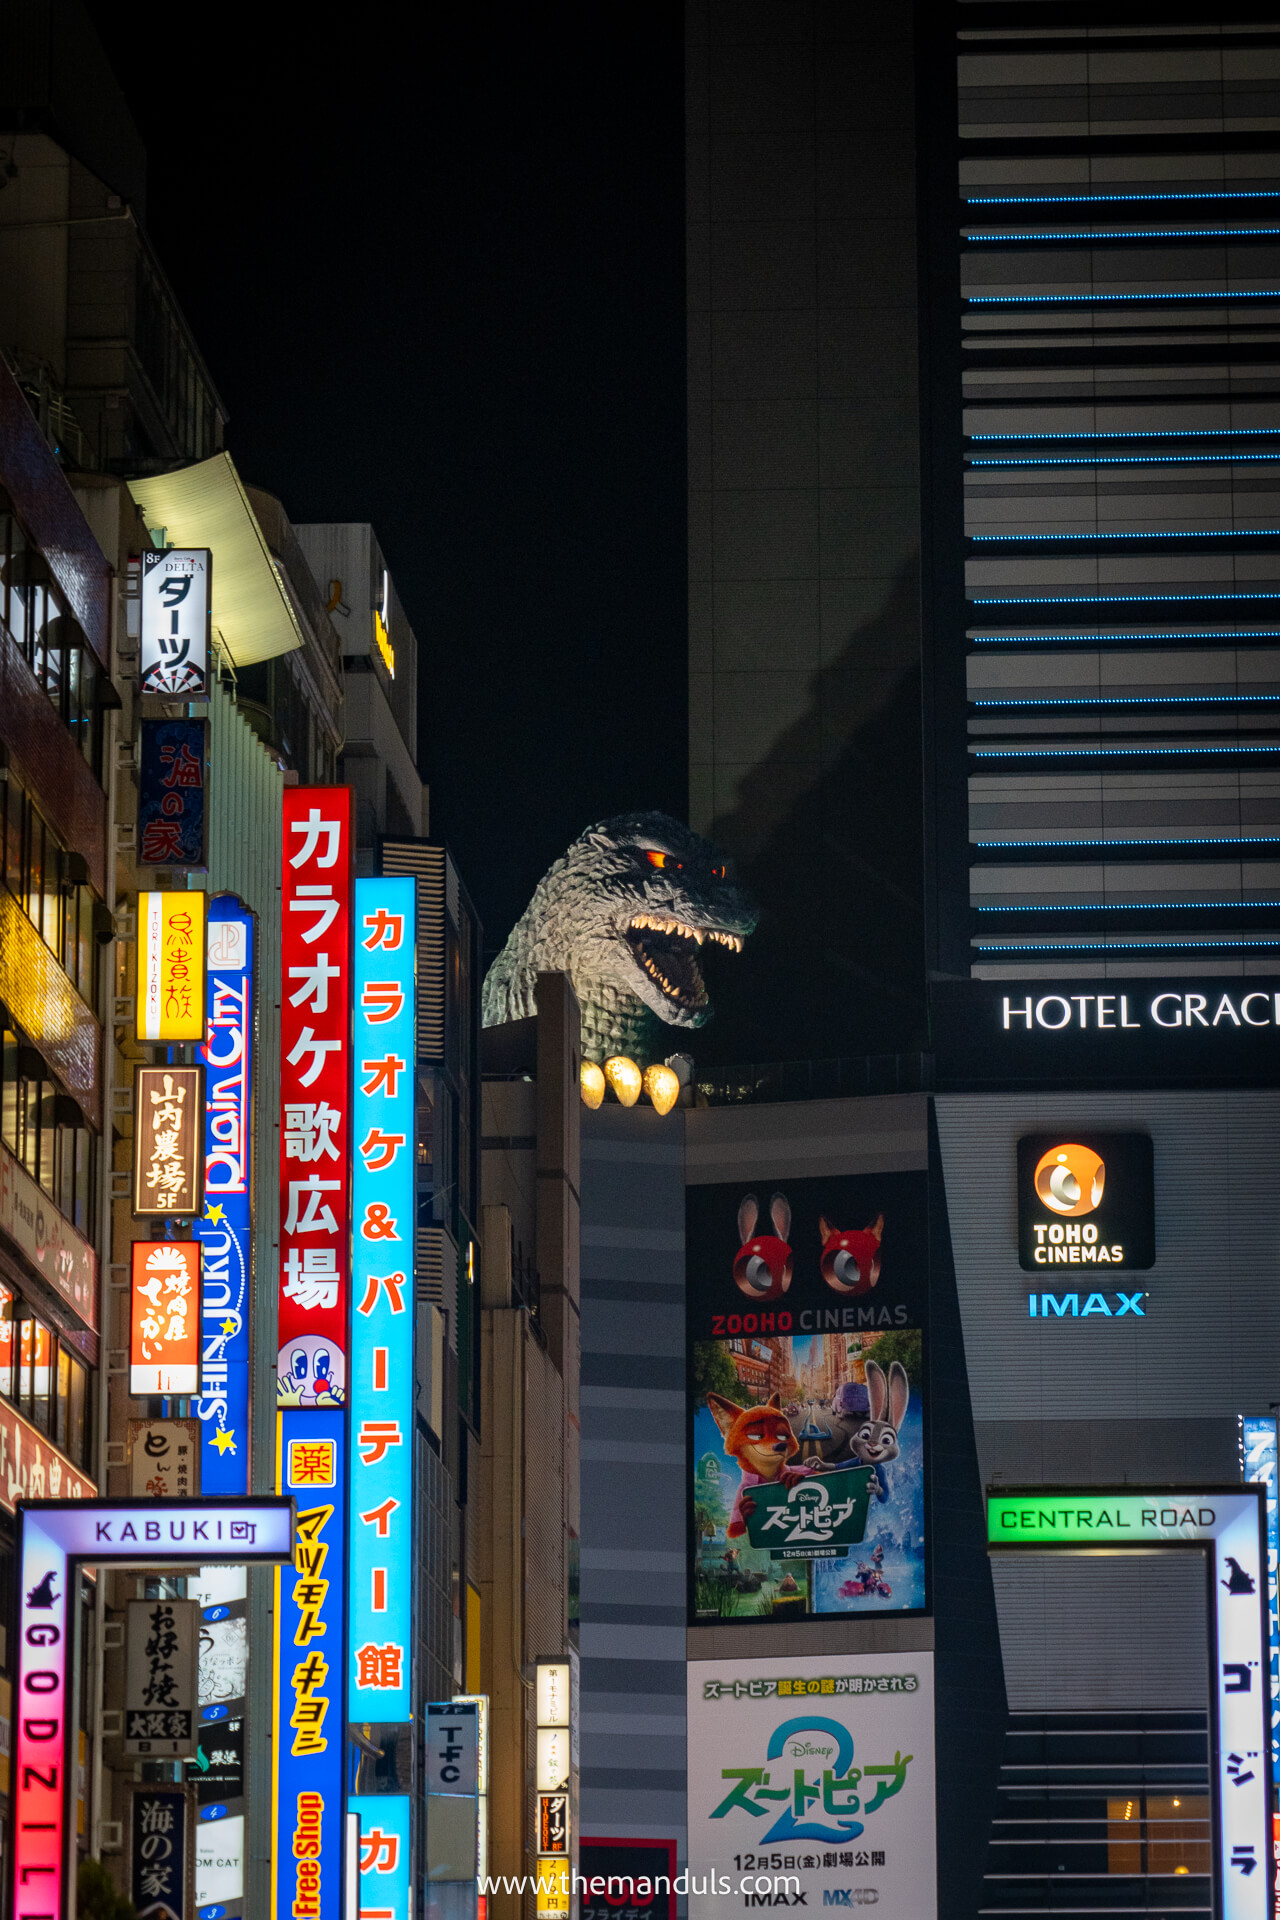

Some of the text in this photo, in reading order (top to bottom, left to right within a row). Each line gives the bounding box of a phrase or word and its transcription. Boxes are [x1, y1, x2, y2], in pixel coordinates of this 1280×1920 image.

[146, 552, 160, 564] 8F
[165, 563, 204, 572] DELTA
[158, 573, 193, 669] ダーツ
[1002, 994, 1141, 1029] HOTEL
[283, 808, 342, 1310] カラオケ歌広場
[145, 1074, 187, 1193] 山内農場
[156, 1193, 177, 1208] 5F
[1033, 1223, 1098, 1244] TOHO
[1033, 1245, 1123, 1264] CINEMAS
[163, 1269, 192, 1341] 焼肉屋
[355, 908, 406, 1690] カラオケ&パーティー館
[1028, 1292, 1146, 1317] IMAX
[136, 1277, 165, 1360] さかい
[197, 1231, 242, 1421] SHINJUKU
[712, 1305, 908, 1335] ZOOHO CINEMAS
[294, 1446, 331, 1483] 薬
[760, 1497, 856, 1531] ズートピア
[1000, 1508, 1217, 1529] CENTRAL ROAD
[211, 1608, 222, 1620] 6
[291, 1505, 334, 1755] マツモトキヨシ
[142, 1604, 179, 1708] お好み焼
[705, 1676, 918, 1698] ズートピア誕生の謎が明かされる
[129, 1712, 188, 1738] 大阪家
[210, 1707, 220, 1719] 5
[20, 1623, 61, 1920] GODZIL
[439, 1726, 463, 1784] TFC
[1223, 1661, 1259, 1877] ゴジラ
[708, 1750, 913, 1819] ズートピア
[210, 1807, 218, 1818] 4
[549, 1797, 565, 1841] ダーツ
[141, 1801, 174, 1897] 海の家
[216, 1859, 240, 1867] CAT
[294, 1793, 322, 1916] Free Shop
[733, 1851, 886, 1871] 12月5日(金)劇場公開
[360, 1829, 399, 1920] カ
[207, 1907, 217, 1919] 3
[744, 1888, 880, 1909] IMAX MX4D
